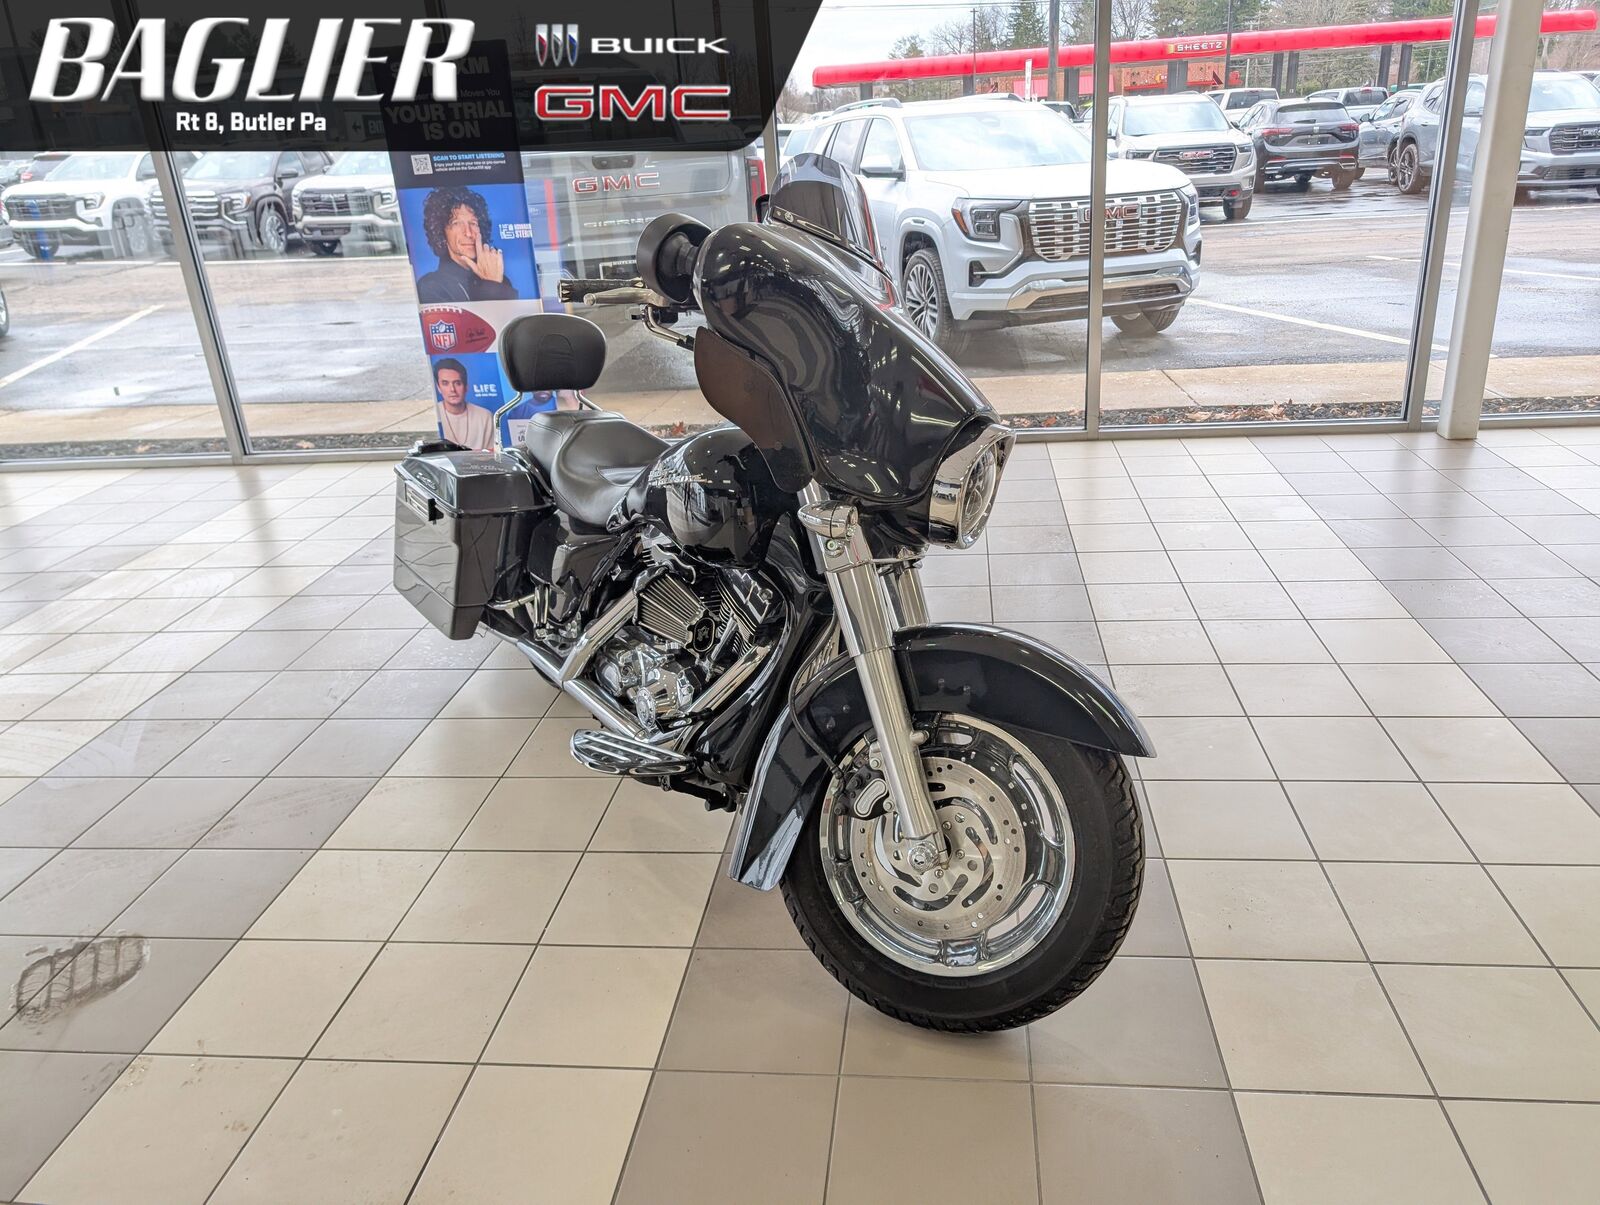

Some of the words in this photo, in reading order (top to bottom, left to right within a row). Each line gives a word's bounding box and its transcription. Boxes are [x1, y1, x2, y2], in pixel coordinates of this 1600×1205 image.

[1176, 41, 1223, 52] SHEETZ
[384, 105, 446, 124] YOUR
[448, 101, 512, 119] TRIAL
[424, 122, 444, 141] IS
[448, 120, 481, 139] ON
[572, 172, 660, 193] GMC
[434, 334, 453, 346] NFL
[473, 383, 497, 393] LIFE
